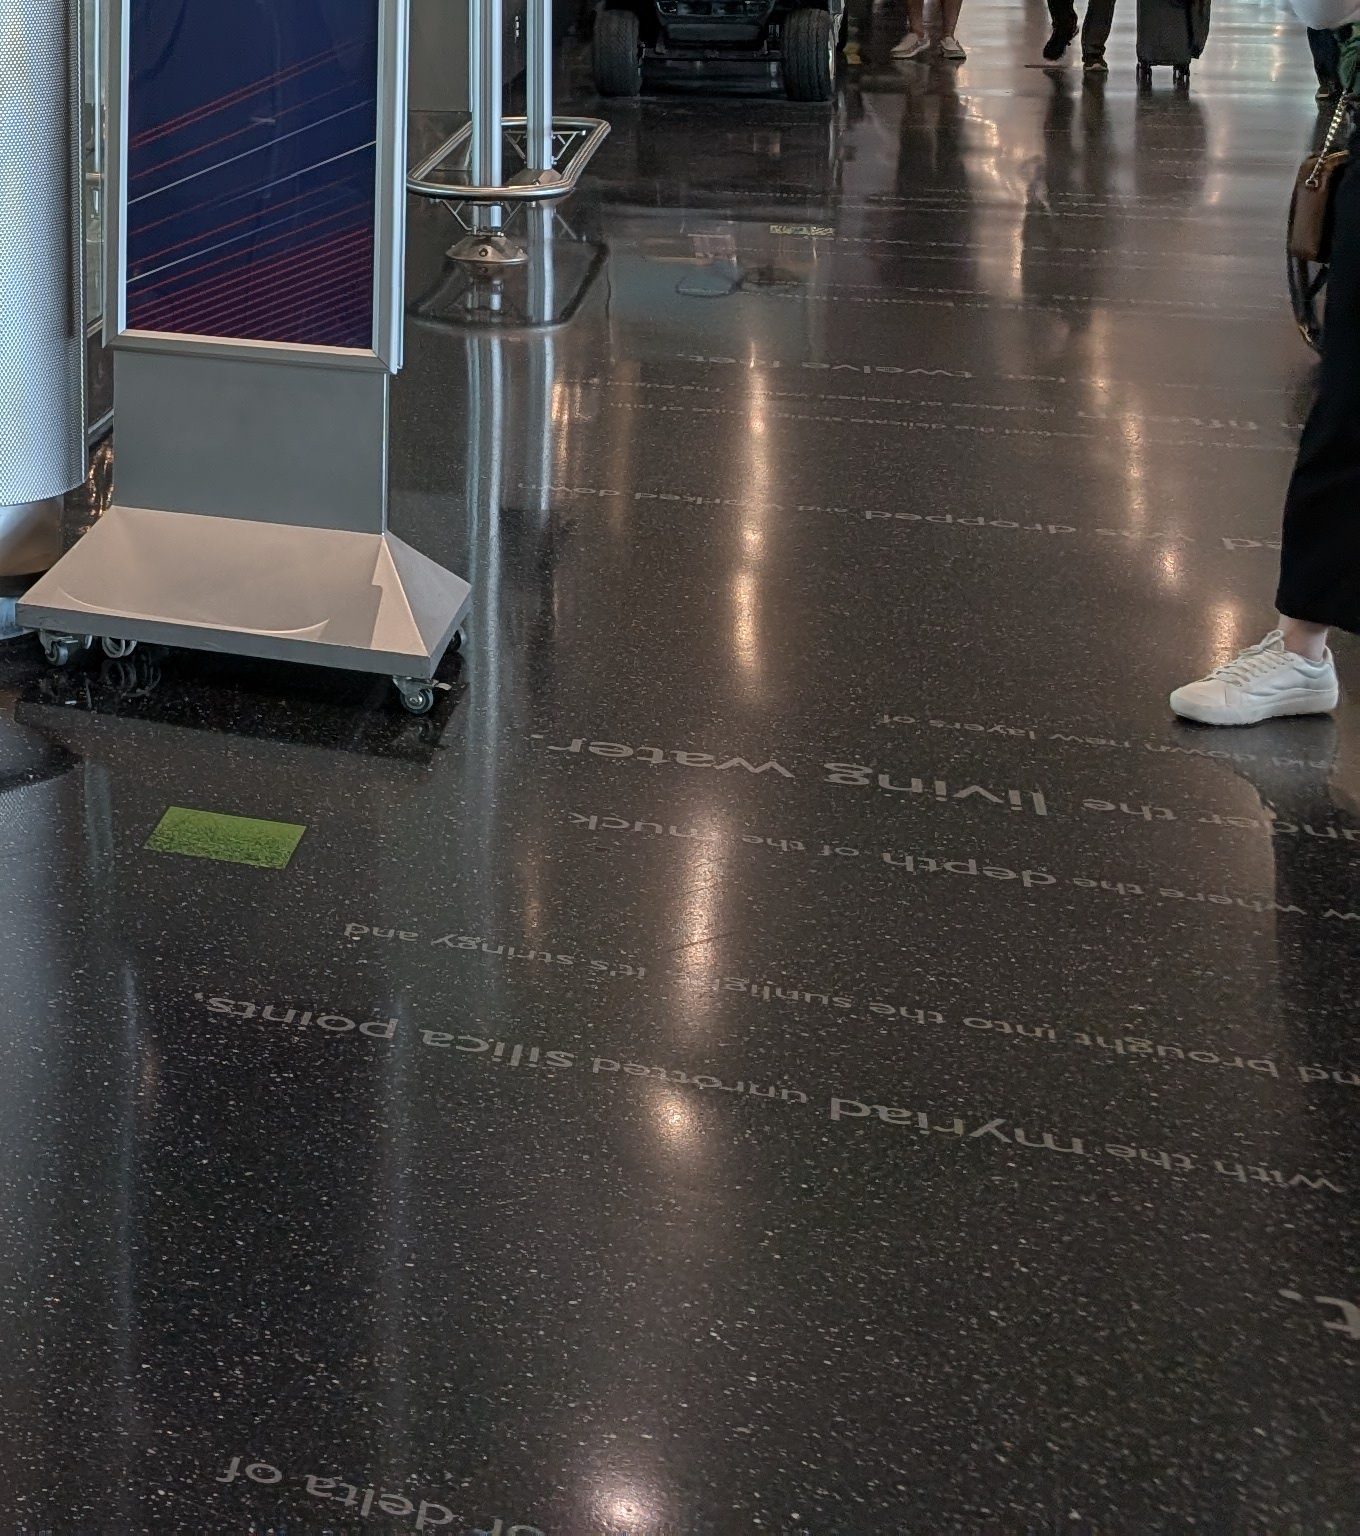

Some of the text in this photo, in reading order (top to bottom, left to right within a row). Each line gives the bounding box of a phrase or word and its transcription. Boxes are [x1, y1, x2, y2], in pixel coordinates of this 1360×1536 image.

[866, 510, 1078, 534] dropped
[824, 762, 1049, 817] living
[1081, 798, 1177, 822] the
[741, 834, 806, 852] the
[817, 844, 860, 857] of
[882, 852, 1057, 889] depth
[1072, 877, 1145, 896] the
[343, 921, 420, 944] and
[430, 933, 575, 966] stringy
[868, 1001, 944, 1027] the
[962, 1015, 1057, 1044] into
[419, 1028, 576, 1071] silica
[1076, 1029, 1277, 1079] brought
[1297, 1065, 1360, 1086] nd
[830, 1097, 1084, 1157] myriad
[1105, 1142, 1193, 1171] the
[1215, 1163, 1347, 1193] with
[215, 1456, 283, 1485] of
[304, 1474, 455, 1533] delta
